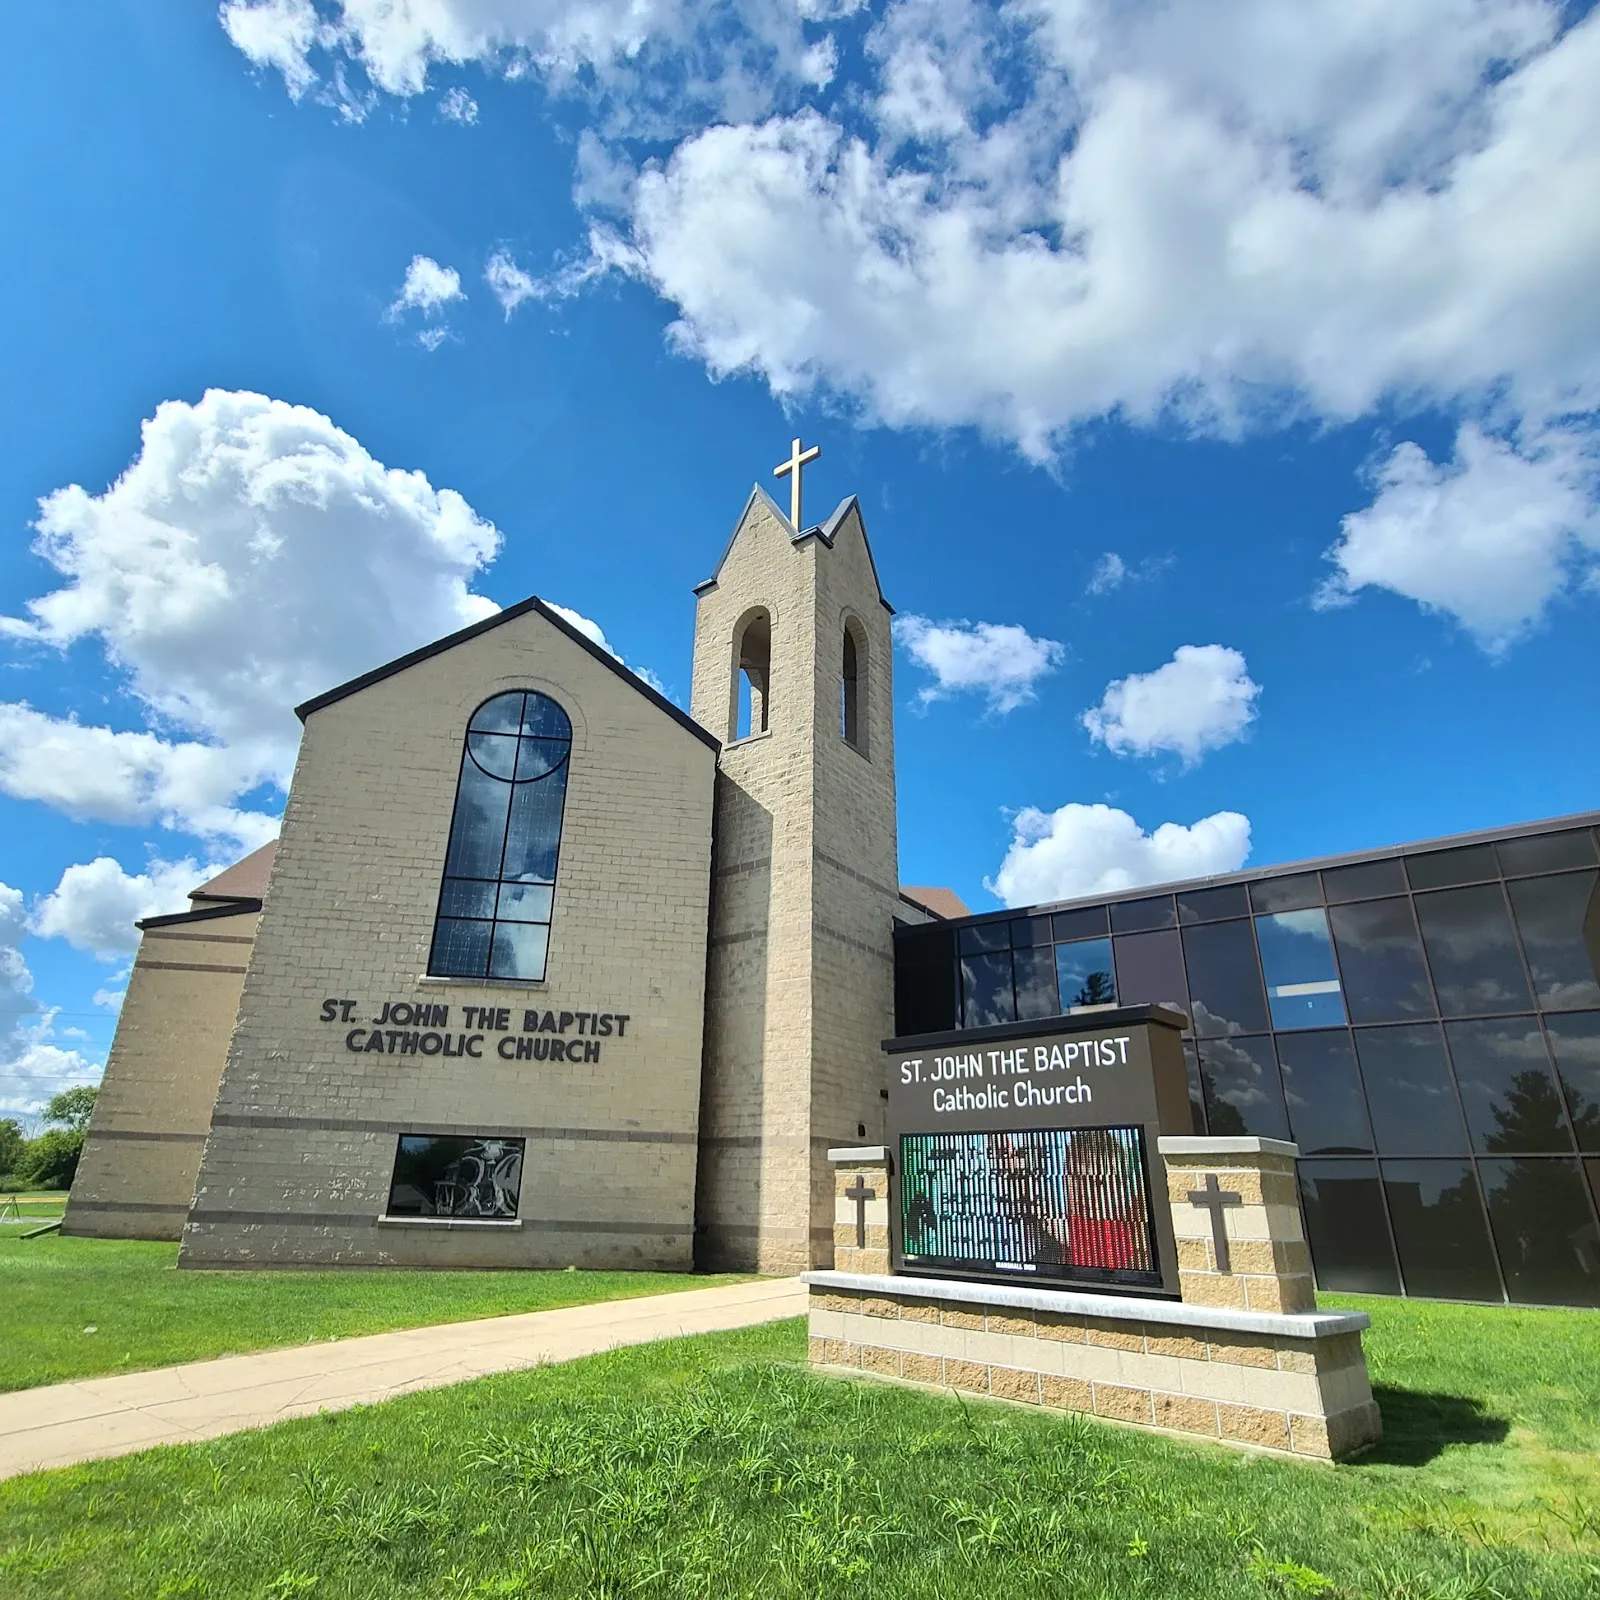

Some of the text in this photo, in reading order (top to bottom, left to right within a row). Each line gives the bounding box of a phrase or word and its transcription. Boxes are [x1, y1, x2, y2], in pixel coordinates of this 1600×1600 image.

[320, 999, 630, 1036] ST. JOHN THE BAPTIST
[345, 1029, 600, 1063] CATHOLIC CHURCH
[901, 1037, 1130, 1084] ST. JOHN THE BAPTIST
[933, 1076, 1092, 1112] Catholic Church
